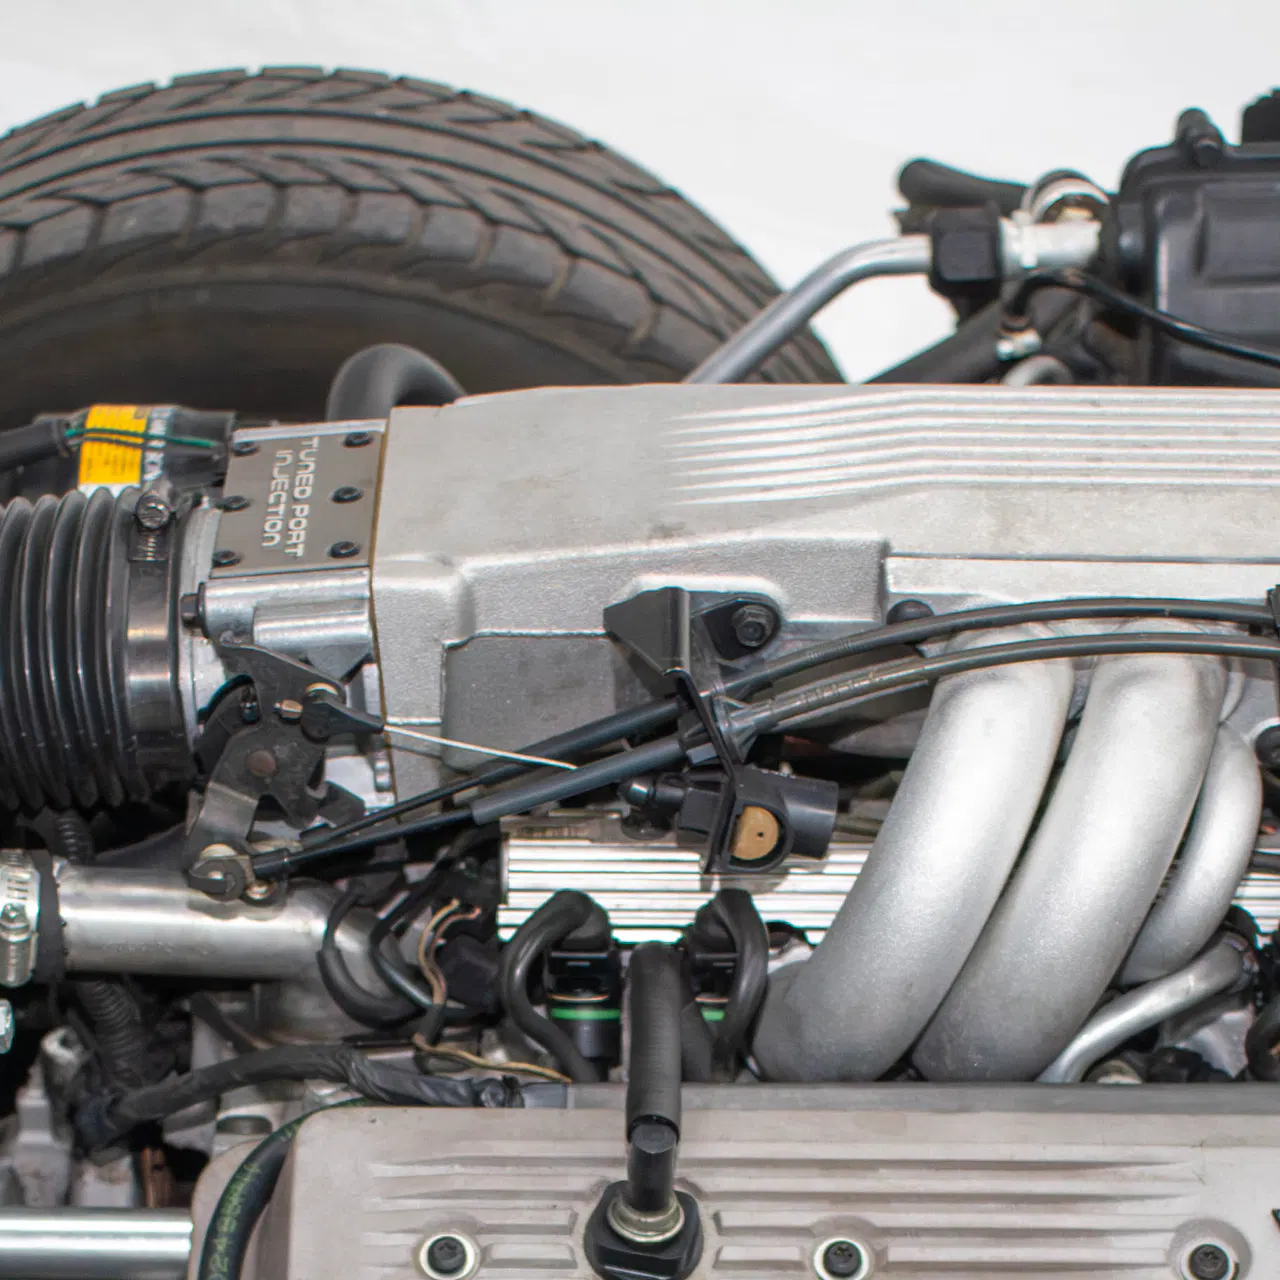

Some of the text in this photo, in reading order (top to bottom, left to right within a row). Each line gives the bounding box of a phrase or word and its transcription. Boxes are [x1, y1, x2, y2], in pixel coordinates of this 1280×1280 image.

[262, 449, 293, 547] INJECTION
[285, 437, 320, 557] TUNED PORT
